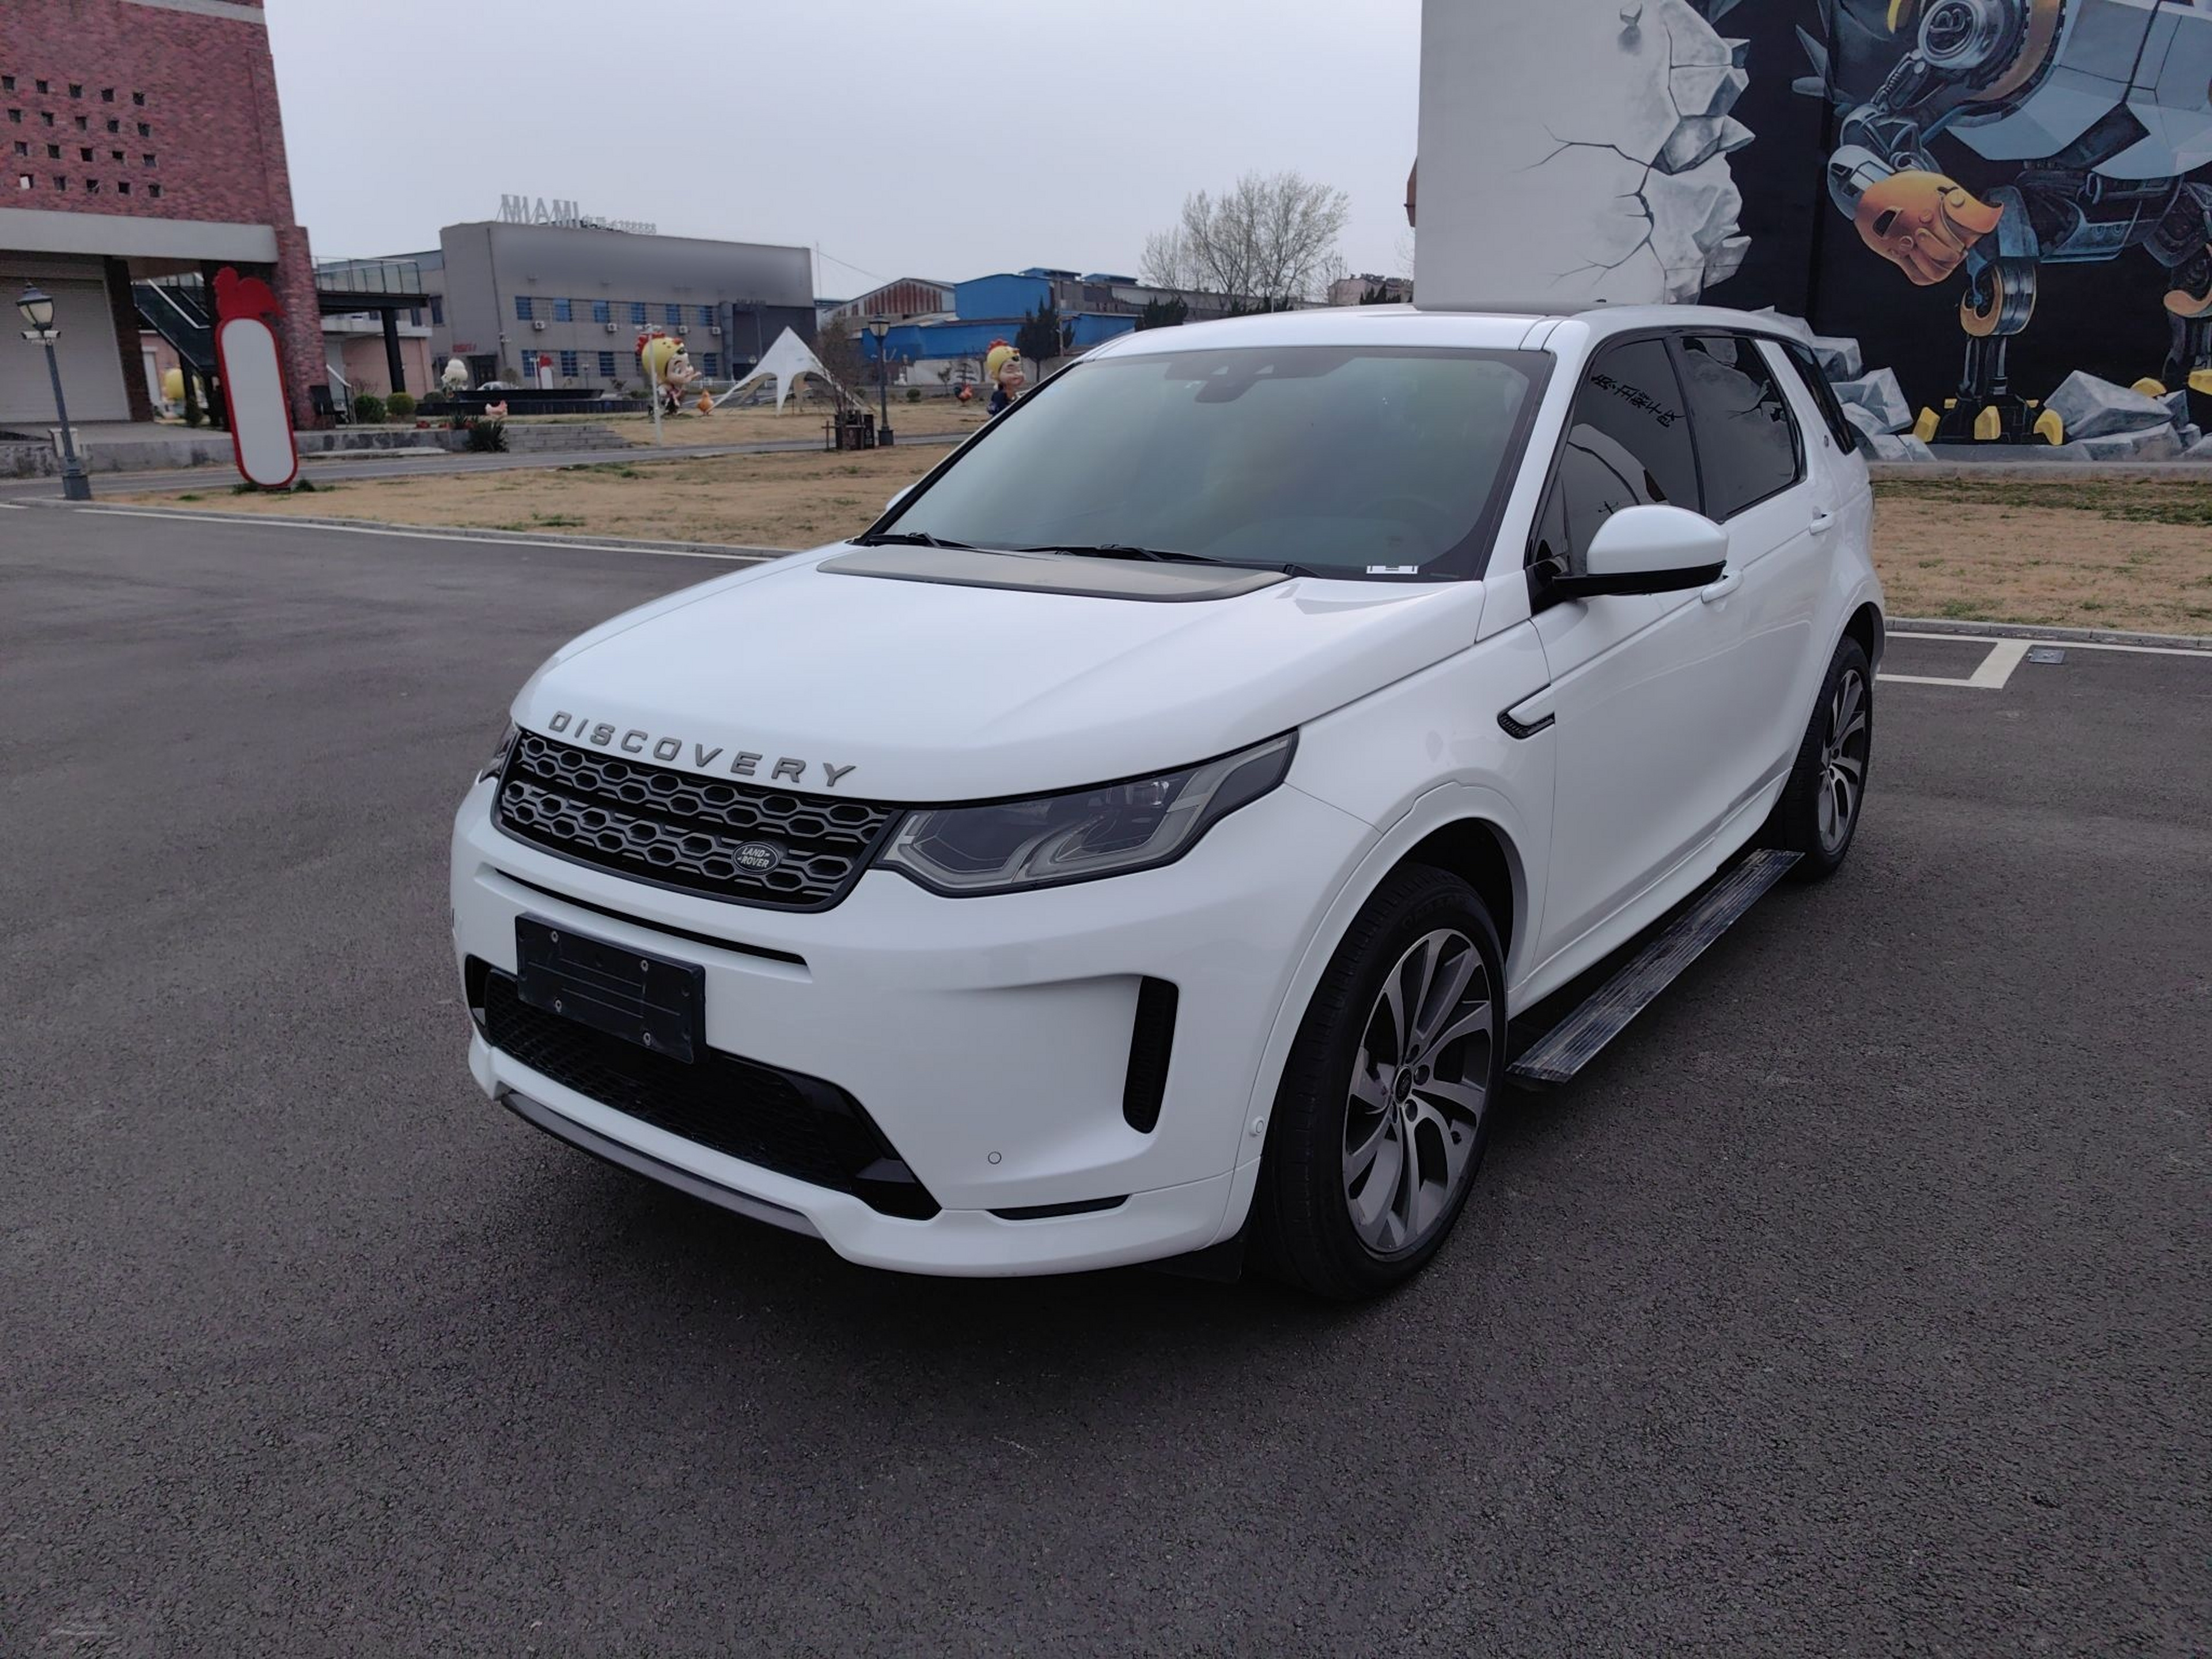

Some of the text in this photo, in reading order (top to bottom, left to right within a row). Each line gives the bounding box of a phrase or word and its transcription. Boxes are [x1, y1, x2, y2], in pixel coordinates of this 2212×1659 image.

[501, 194, 579, 229] MIAMI
[548, 710, 856, 787] DISCOVERY
[740, 855, 770, 868] ROVER
[741, 847, 766, 858] LAND
